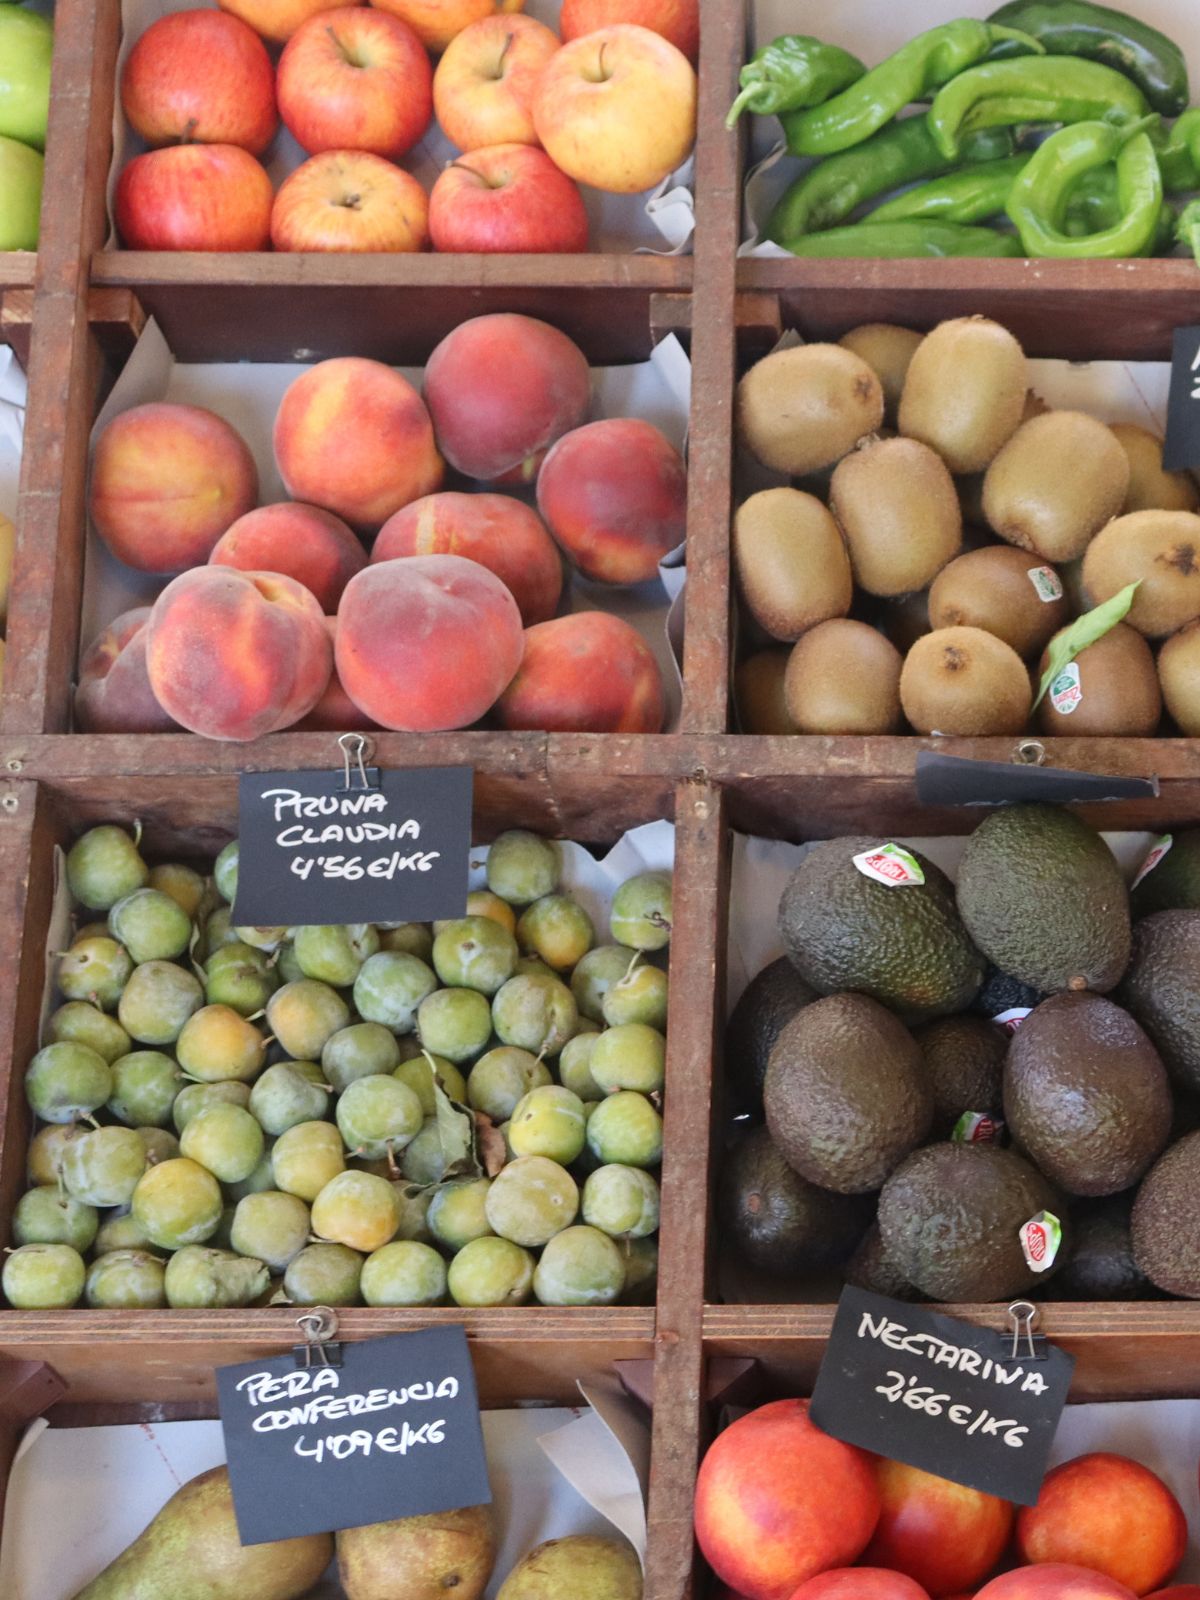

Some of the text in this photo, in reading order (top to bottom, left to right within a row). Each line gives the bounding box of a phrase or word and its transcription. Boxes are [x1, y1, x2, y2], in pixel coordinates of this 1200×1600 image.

[260, 788, 388, 822] PRUNA
[275, 819, 421, 847] CLAUDIA
[857, 1312, 1050, 1396] NECTARINA
[235, 1368, 340, 1407] PERA
[251, 1376, 459, 1433] CONFERENCIA
